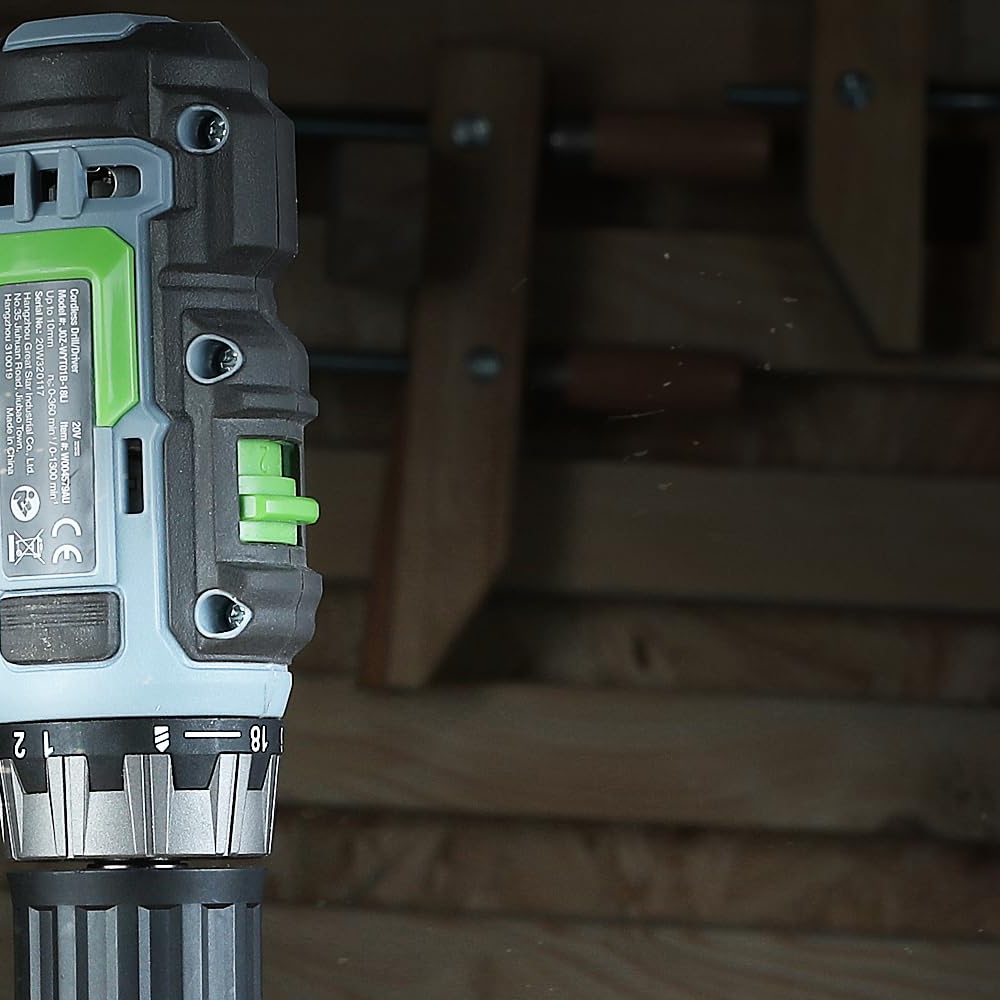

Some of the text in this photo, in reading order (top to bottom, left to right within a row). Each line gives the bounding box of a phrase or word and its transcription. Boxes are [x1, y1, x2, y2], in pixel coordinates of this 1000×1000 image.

[35, 291, 43, 316] Serial
[58, 289, 66, 316] Model
[45, 290, 55, 347] Up to 10mm
[70, 288, 80, 373] Cordless Drill/Driver
[3, 294, 13, 379] Hangzhou 310019
[14, 322, 22, 359] Jiuhuan
[14, 362, 23, 390] Road,
[36, 338, 44, 396] 20W320117
[23, 292, 34, 475] Hangzhou Great Star Industrial Co., Ltd.
[15, 392, 24, 423] Jiubao
[48, 389, 56, 415] 0-360
[6, 408, 15, 475] Made in China
[16, 425, 24, 452] Town,
[72, 421, 81, 439] 20V
[49, 447, 57, 480] 0-1300
[60, 421, 70, 503] Item #: W004579AU
[14, 731, 26, 758] 2
[44, 730, 54, 757] 1
[250, 726, 268, 752] 18
